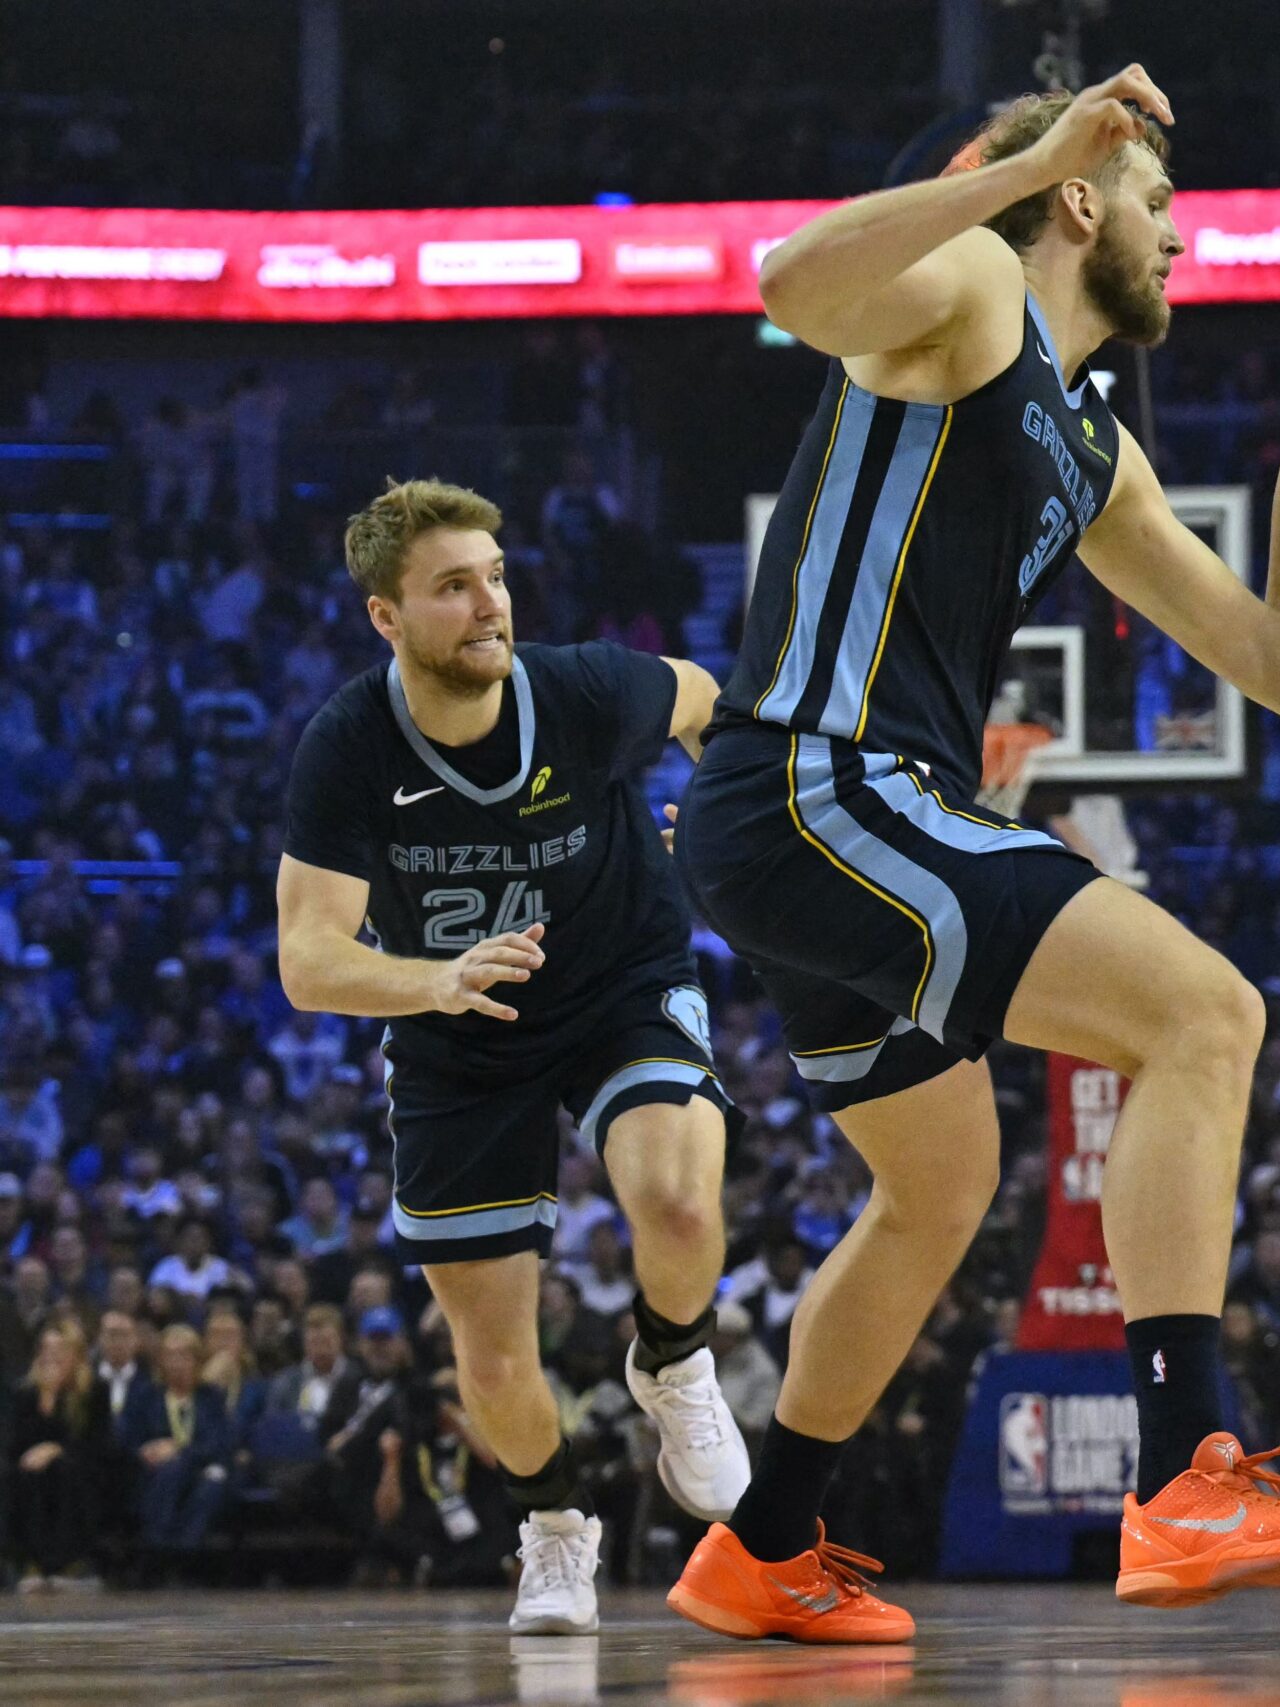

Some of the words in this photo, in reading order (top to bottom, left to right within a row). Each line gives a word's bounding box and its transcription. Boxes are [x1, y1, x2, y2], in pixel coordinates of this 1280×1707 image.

[519, 792, 571, 817] Robinhood
[388, 824, 587, 874] GRIZZLIES
[422, 880, 551, 950] 24
